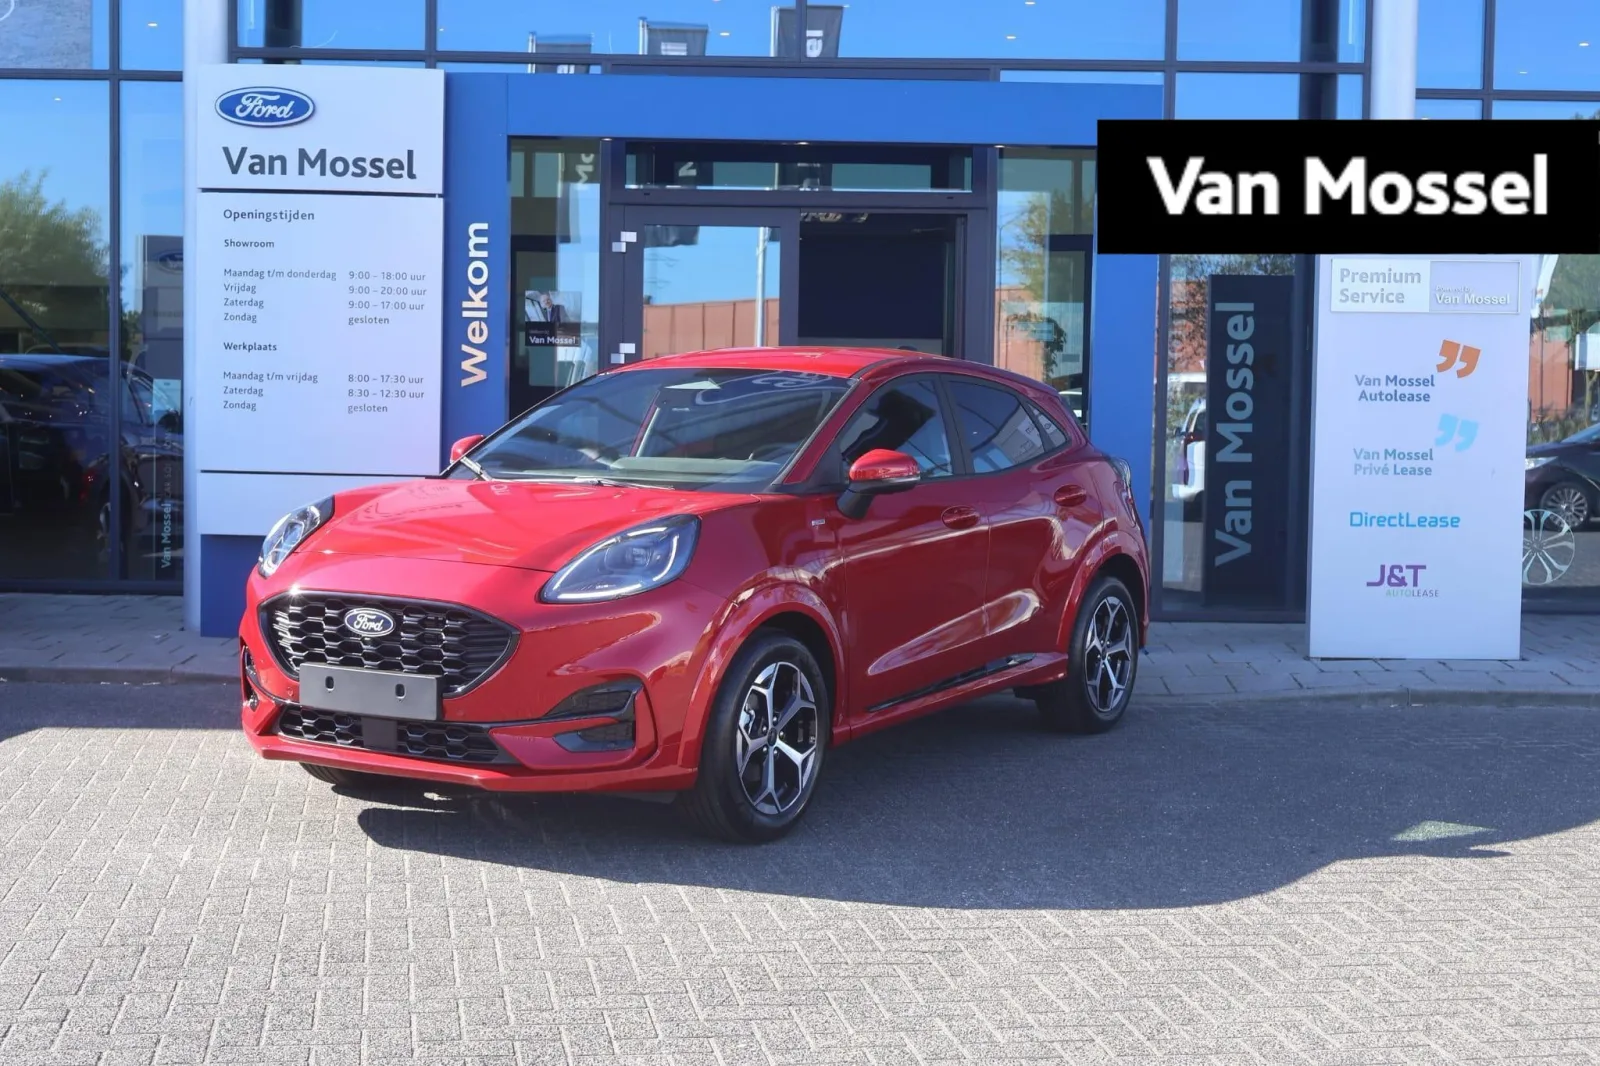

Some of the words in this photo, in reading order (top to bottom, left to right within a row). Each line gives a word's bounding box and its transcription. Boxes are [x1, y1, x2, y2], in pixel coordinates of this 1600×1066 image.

[235, 93, 295, 118] Ford
[222, 146, 288, 176] Van
[298, 148, 417, 180] Mossel
[223, 209, 315, 223] Openingstijden
[224, 239, 275, 249] Showroom
[223, 269, 265, 280] Maandag
[267, 269, 285, 278] t/m
[287, 269, 337, 281] donderdag
[348, 271, 371, 280] 9:00
[381, 272, 408, 281] 18:00
[1339, 268, 1422, 284] Premium
[223, 283, 257, 294] Vrijdag
[348, 286, 371, 294] 9:00
[380, 287, 408, 295] 20:00
[1339, 288, 1406, 304] Service
[223, 298, 265, 309] Zaterdag
[348, 300, 371, 309] 9:00
[381, 301, 407, 310] 17:00
[461, 222, 489, 387] Welkom
[1436, 293, 1459, 304] Van
[1464, 294, 1510, 305] Mossel
[223, 312, 257, 323] Zondag
[348, 315, 390, 326] gesloten
[529, 335, 545, 344] Van
[546, 336, 576, 345] Mossel
[223, 342, 278, 353] Werkplaats
[223, 371, 264, 382] Maandag
[266, 372, 284, 381] t/m
[286, 372, 319, 384] vrijdag
[348, 374, 370, 383] 8:00
[380, 374, 406, 384] 17:30
[1214, 302, 1255, 464] Mossel
[1355, 374, 1381, 387] Van
[1385, 375, 1435, 387] Mossel
[223, 386, 264, 397] Zaterdag
[348, 388, 370, 397] 8:30
[380, 389, 407, 398] 12:30
[409, 391, 425, 399] uur
[1358, 390, 1431, 403] Autolease
[223, 400, 257, 411] Zondag
[347, 403, 388, 414] gesloten
[1353, 448, 1380, 460] Van
[1384, 449, 1434, 461] Mossel
[1354, 464, 1390, 476] Privé
[1393, 464, 1433, 476] Lease
[161, 503, 172, 544] Mossel
[1214, 479, 1253, 567] Van
[1349, 511, 1461, 528] DirectLease
[161, 547, 172, 568] Van
[1366, 564, 1427, 588] J&T
[1385, 588, 1440, 598] AUTOLEASE
[353, 613, 384, 631] Ford
